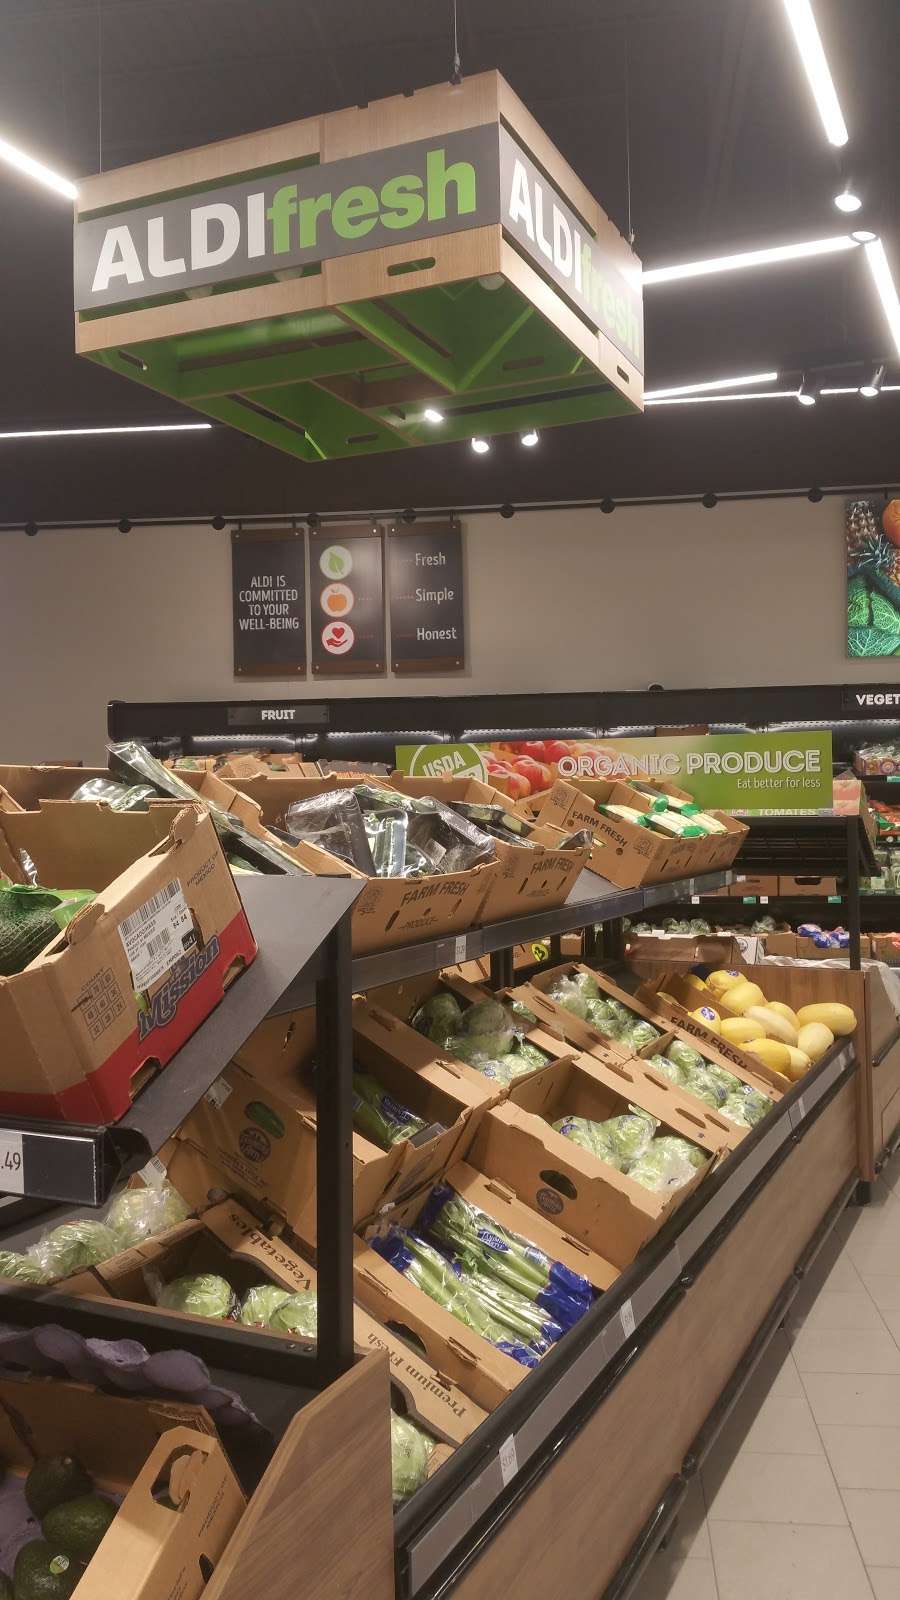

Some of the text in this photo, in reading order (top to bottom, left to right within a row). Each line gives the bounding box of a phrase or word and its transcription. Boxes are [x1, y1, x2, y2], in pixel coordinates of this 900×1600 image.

[90, 148, 477, 292] ALDIfresh
[508, 159, 640, 360] ALDIfresh
[415, 552, 446, 566] Fresh
[250, 575, 286, 588] ALDI IS
[239, 589, 298, 602] COMMITTED
[415, 587, 454, 605] Simple
[248, 603, 289, 616] TO YOUR
[239, 617, 300, 631] WELL-BEING
[416, 627, 458, 641] Honest
[261, 709, 296, 721] FRUIT
[558, 749, 821, 777] ORGANIC PRODUCE
[737, 775, 821, 789] Eat better for less
[571, 811, 628, 847] FARM FRESH
[400, 881, 470, 908] FARM FRESH
[670, 1016, 748, 1069] FARM FRESH
[228, 1213, 312, 1291] Vegetables
[404, 1364, 467, 1418] Premium
